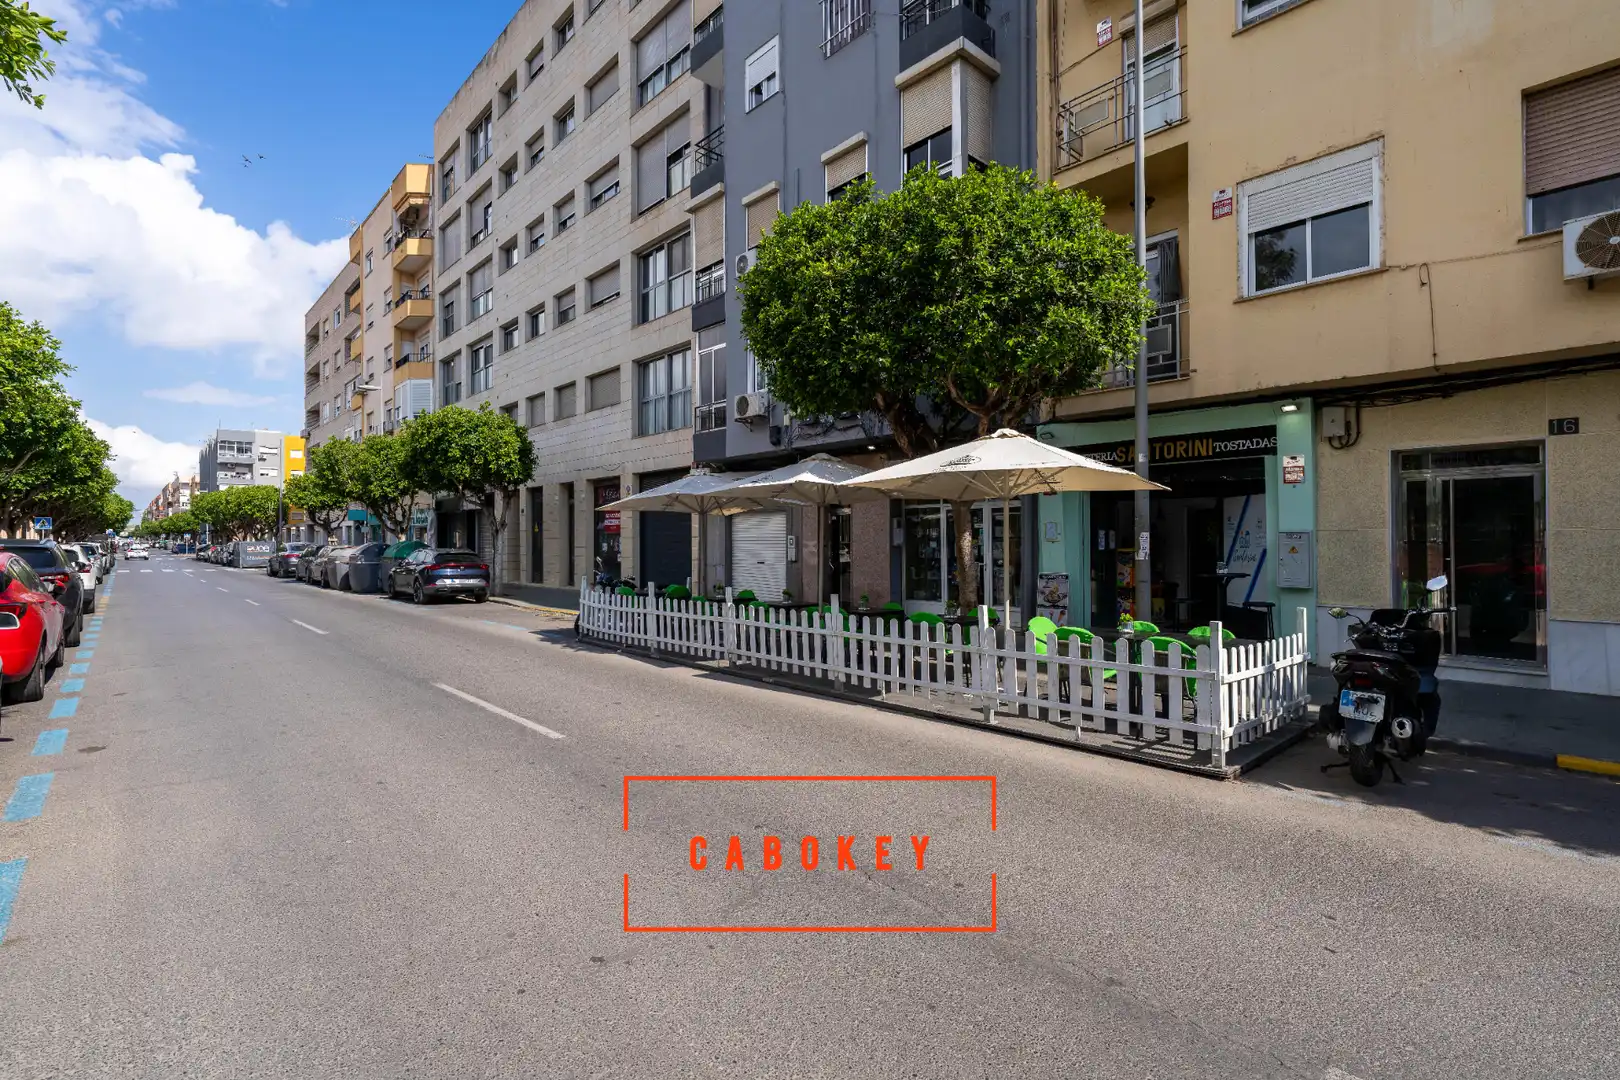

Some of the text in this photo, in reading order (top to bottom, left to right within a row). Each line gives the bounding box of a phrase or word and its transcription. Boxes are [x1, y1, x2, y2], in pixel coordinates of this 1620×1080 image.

[1552, 419, 1575, 434] 16
[1116, 438, 1213, 463] SATORINI
[1213, 436, 1278, 452] TOSTADAS
